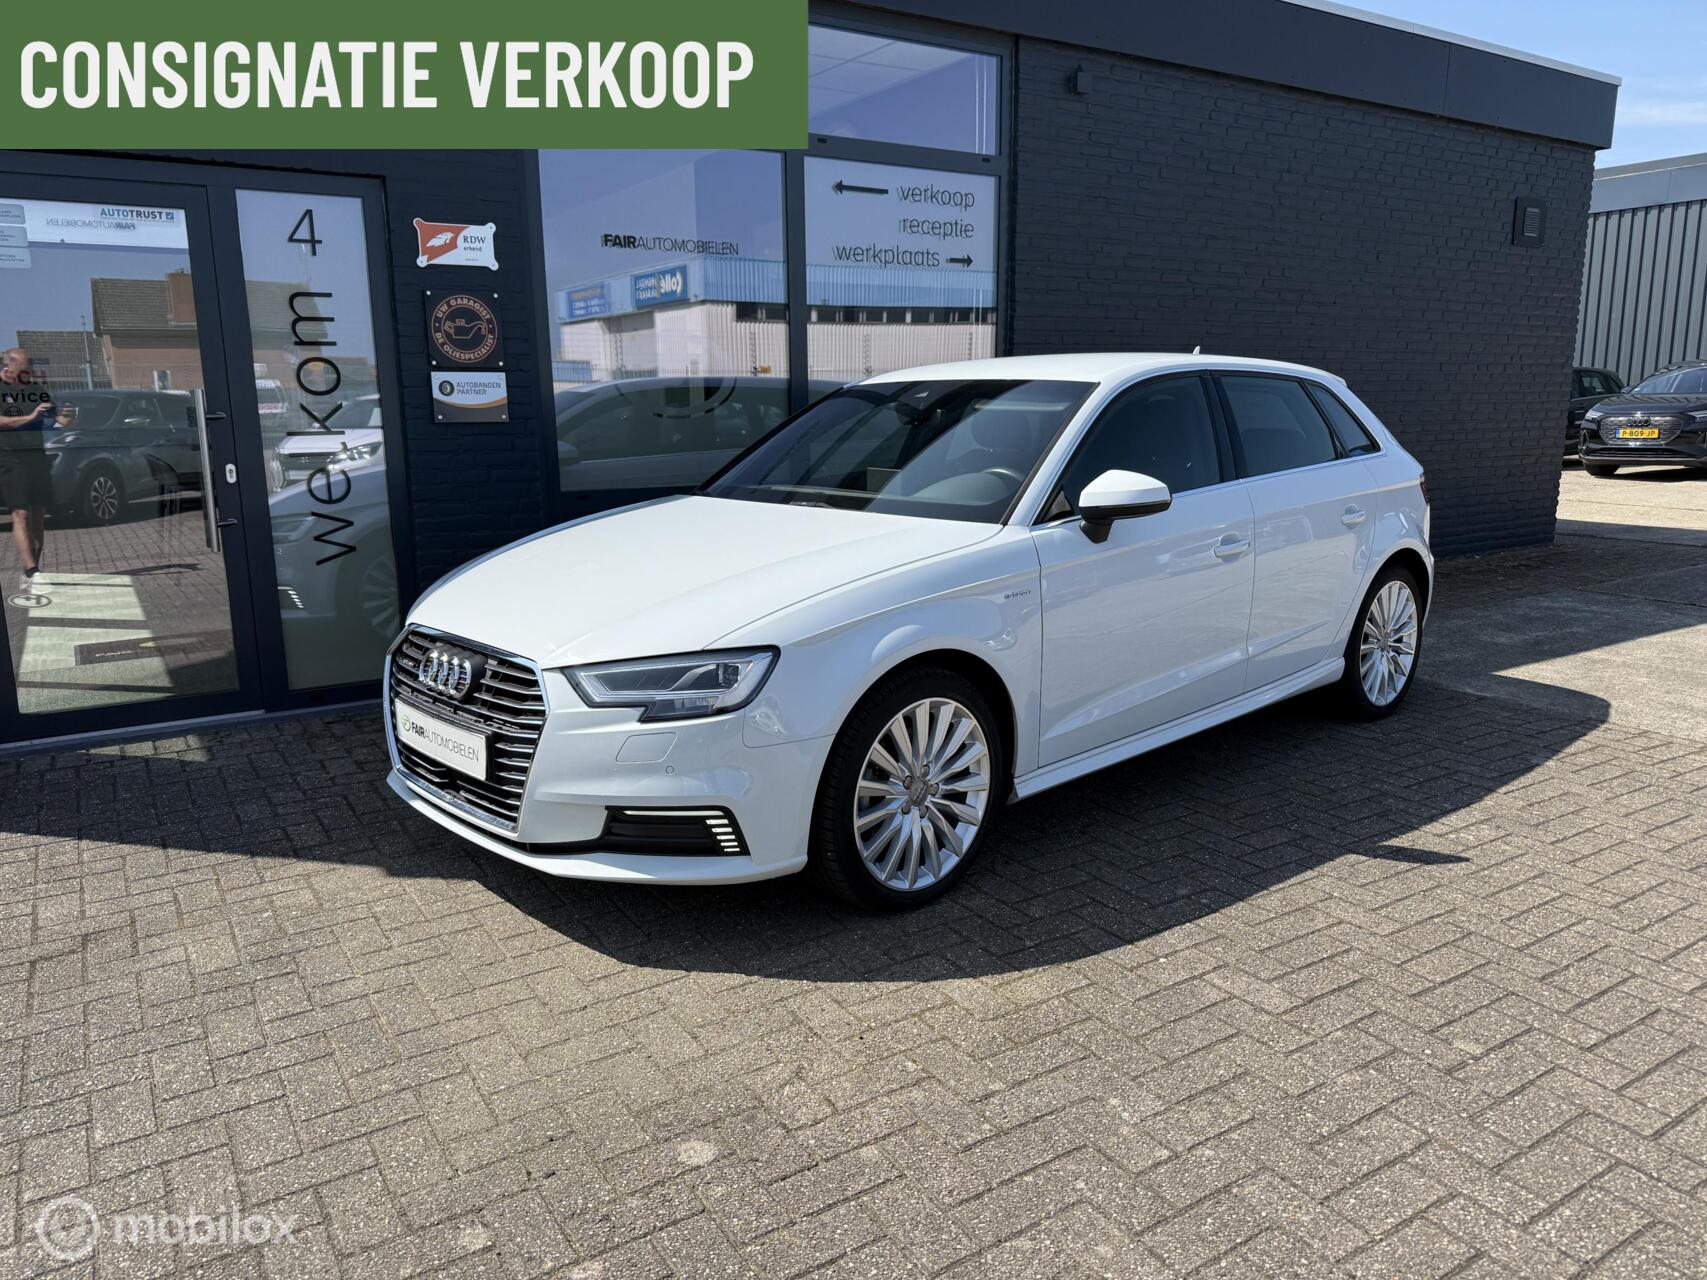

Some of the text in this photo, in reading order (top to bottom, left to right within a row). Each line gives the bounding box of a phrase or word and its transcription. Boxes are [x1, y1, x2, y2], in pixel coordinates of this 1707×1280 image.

[897, 184, 975, 211] verkoop
[100, 208, 164, 220] AUTOTRUST
[288, 209, 322, 256] 4
[463, 235, 487, 245] RDW
[900, 217, 975, 240] receptie
[602, 234, 739, 255] FAIRAUTOMOBIELEN
[834, 243, 941, 269] werkplaats
[436, 298, 491, 320] UW GARAGIST
[435, 332, 494, 360] DE OLIESPECIALIST
[456, 381, 501, 389] AUTOBANDEN
[286, 291, 357, 566] welkom
[411, 721, 480, 763] FAIRAUTOMOBIELEN
